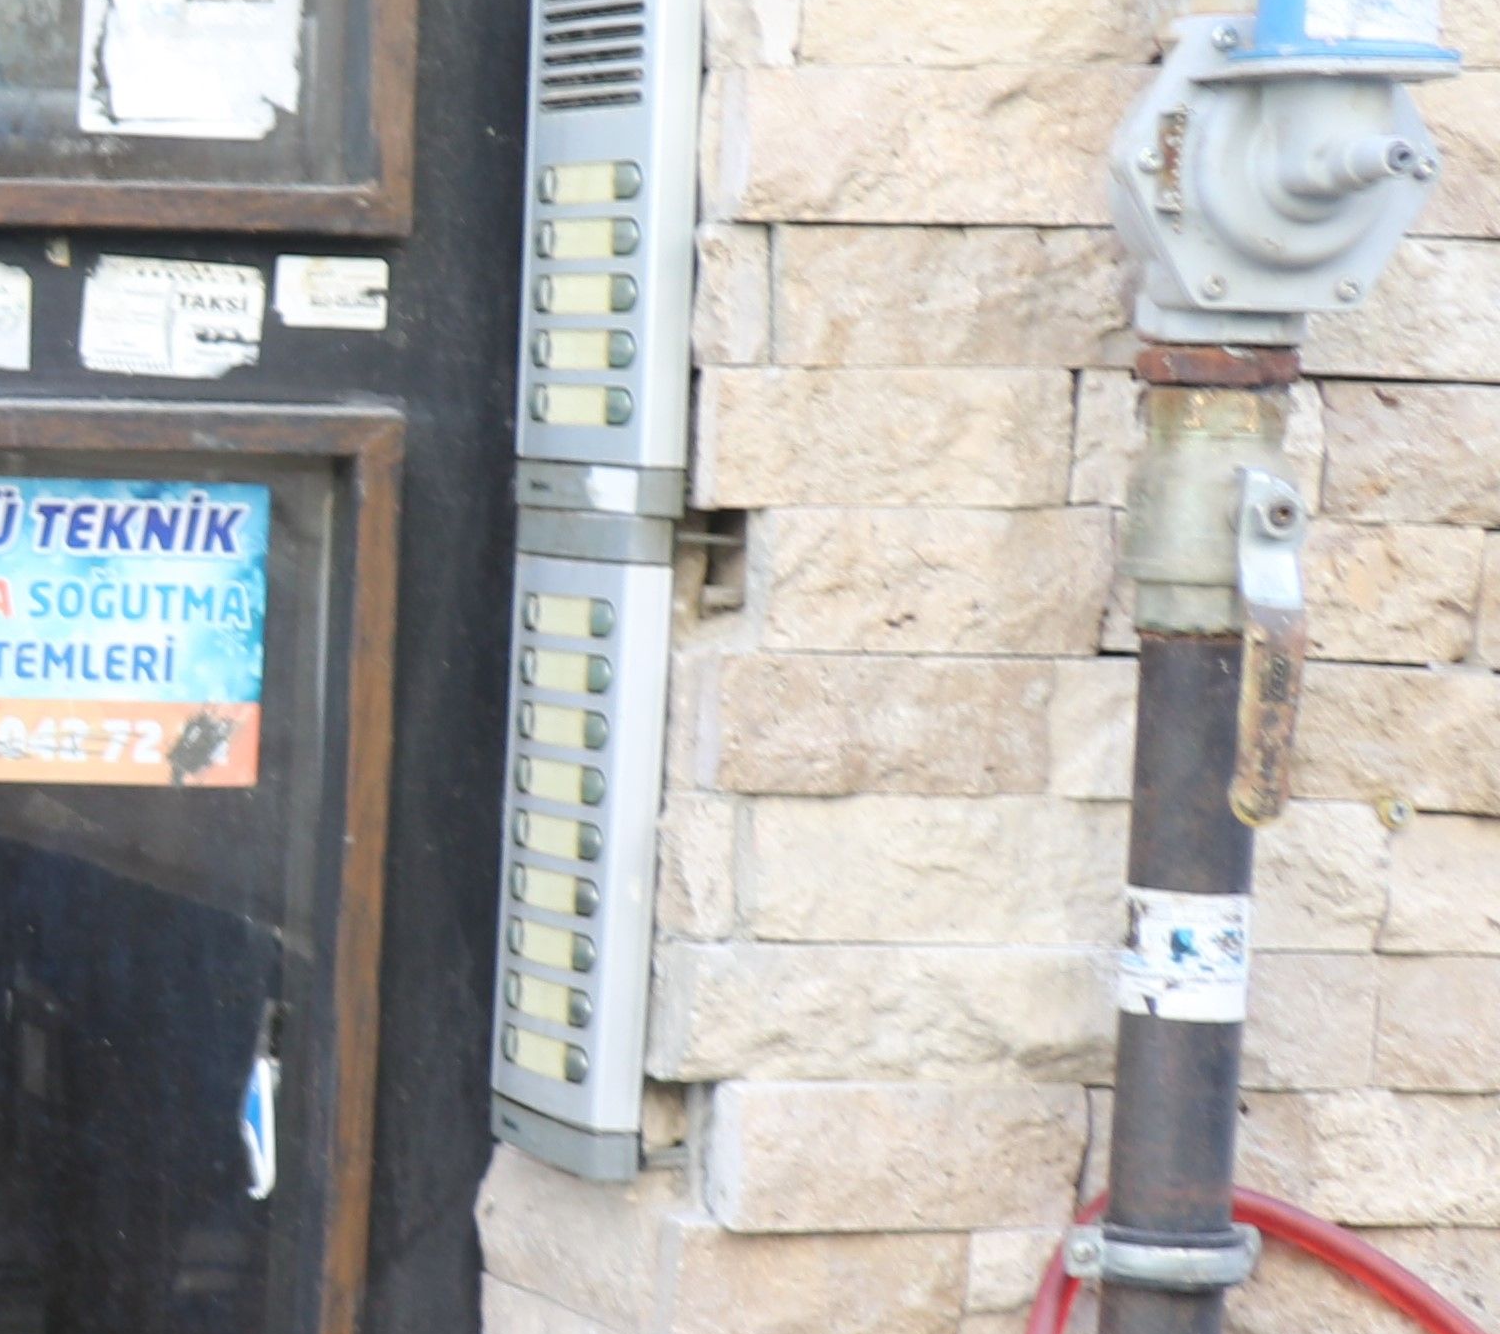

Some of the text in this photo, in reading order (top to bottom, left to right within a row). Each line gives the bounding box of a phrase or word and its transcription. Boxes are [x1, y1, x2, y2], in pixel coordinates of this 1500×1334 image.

[33, 492, 244, 556] TEKNİK
[29, 569, 251, 627] SOĞUTMA
[101, 718, 163, 764] 72
